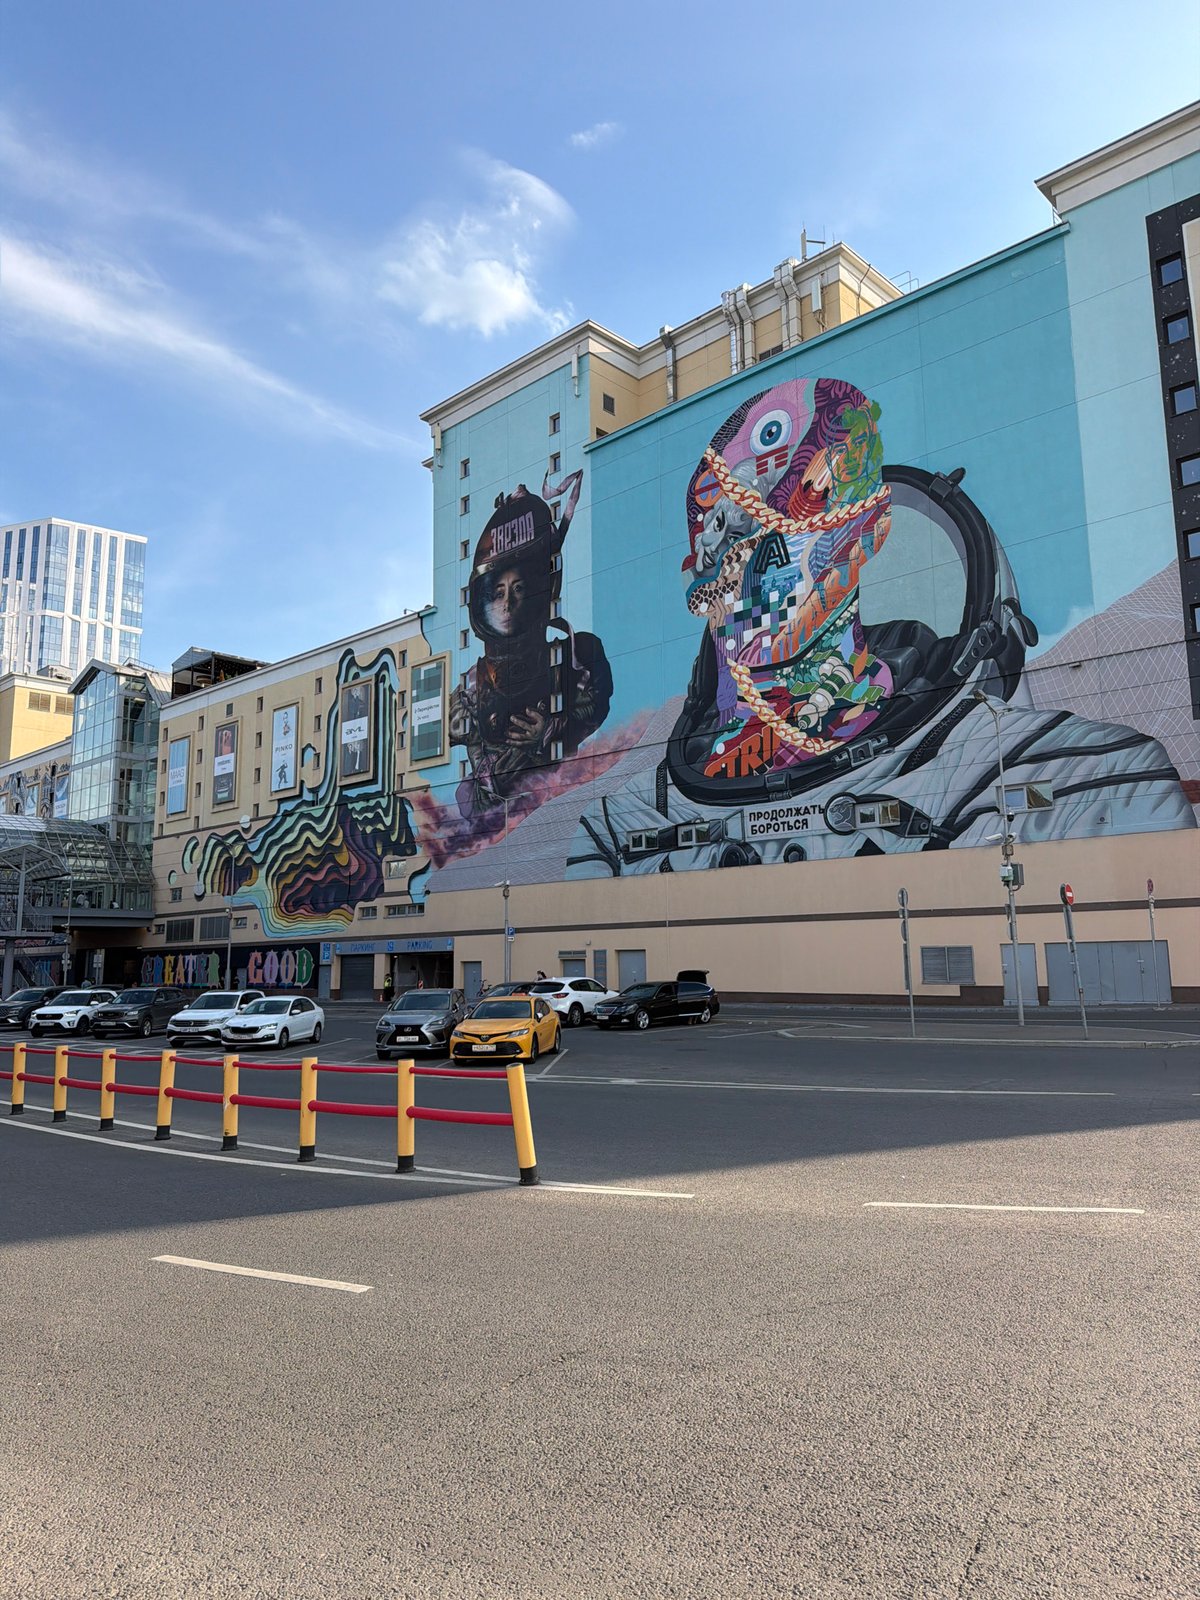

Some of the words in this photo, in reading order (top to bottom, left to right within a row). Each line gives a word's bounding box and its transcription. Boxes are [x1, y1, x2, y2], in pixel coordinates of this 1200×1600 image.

[275, 743, 293, 753] PINKO
[748, 805, 825, 821] ПРОДОЛЖАТЬ
[750, 819, 808, 835] БОРОТЬСЯ
[407, 940, 433, 950] PARKING
[247, 947, 314, 989] GOOD
